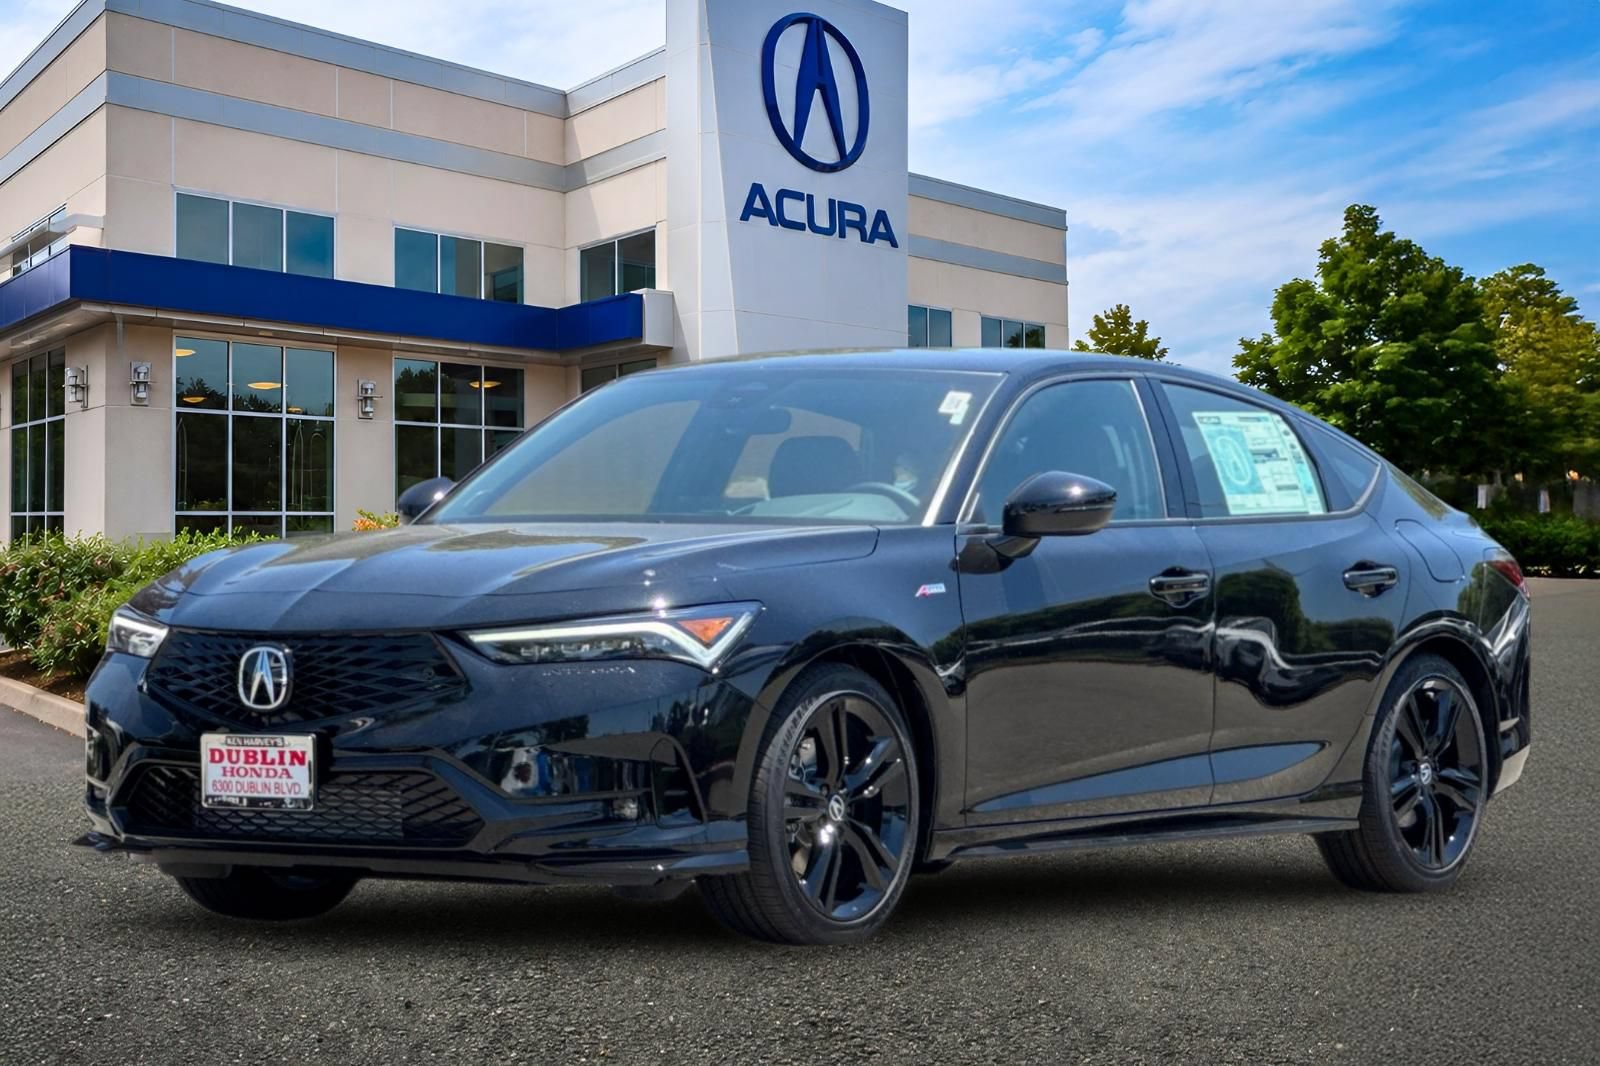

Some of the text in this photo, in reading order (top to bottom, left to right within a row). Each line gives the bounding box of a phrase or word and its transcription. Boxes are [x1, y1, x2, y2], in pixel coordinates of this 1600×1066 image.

[740, 182, 899, 249] ACURA
[208, 748, 307, 766] DUBLIN
[221, 766, 293, 779] HONDA
[212, 780, 233, 793] 6300
[235, 781, 272, 794] DUBLIN
